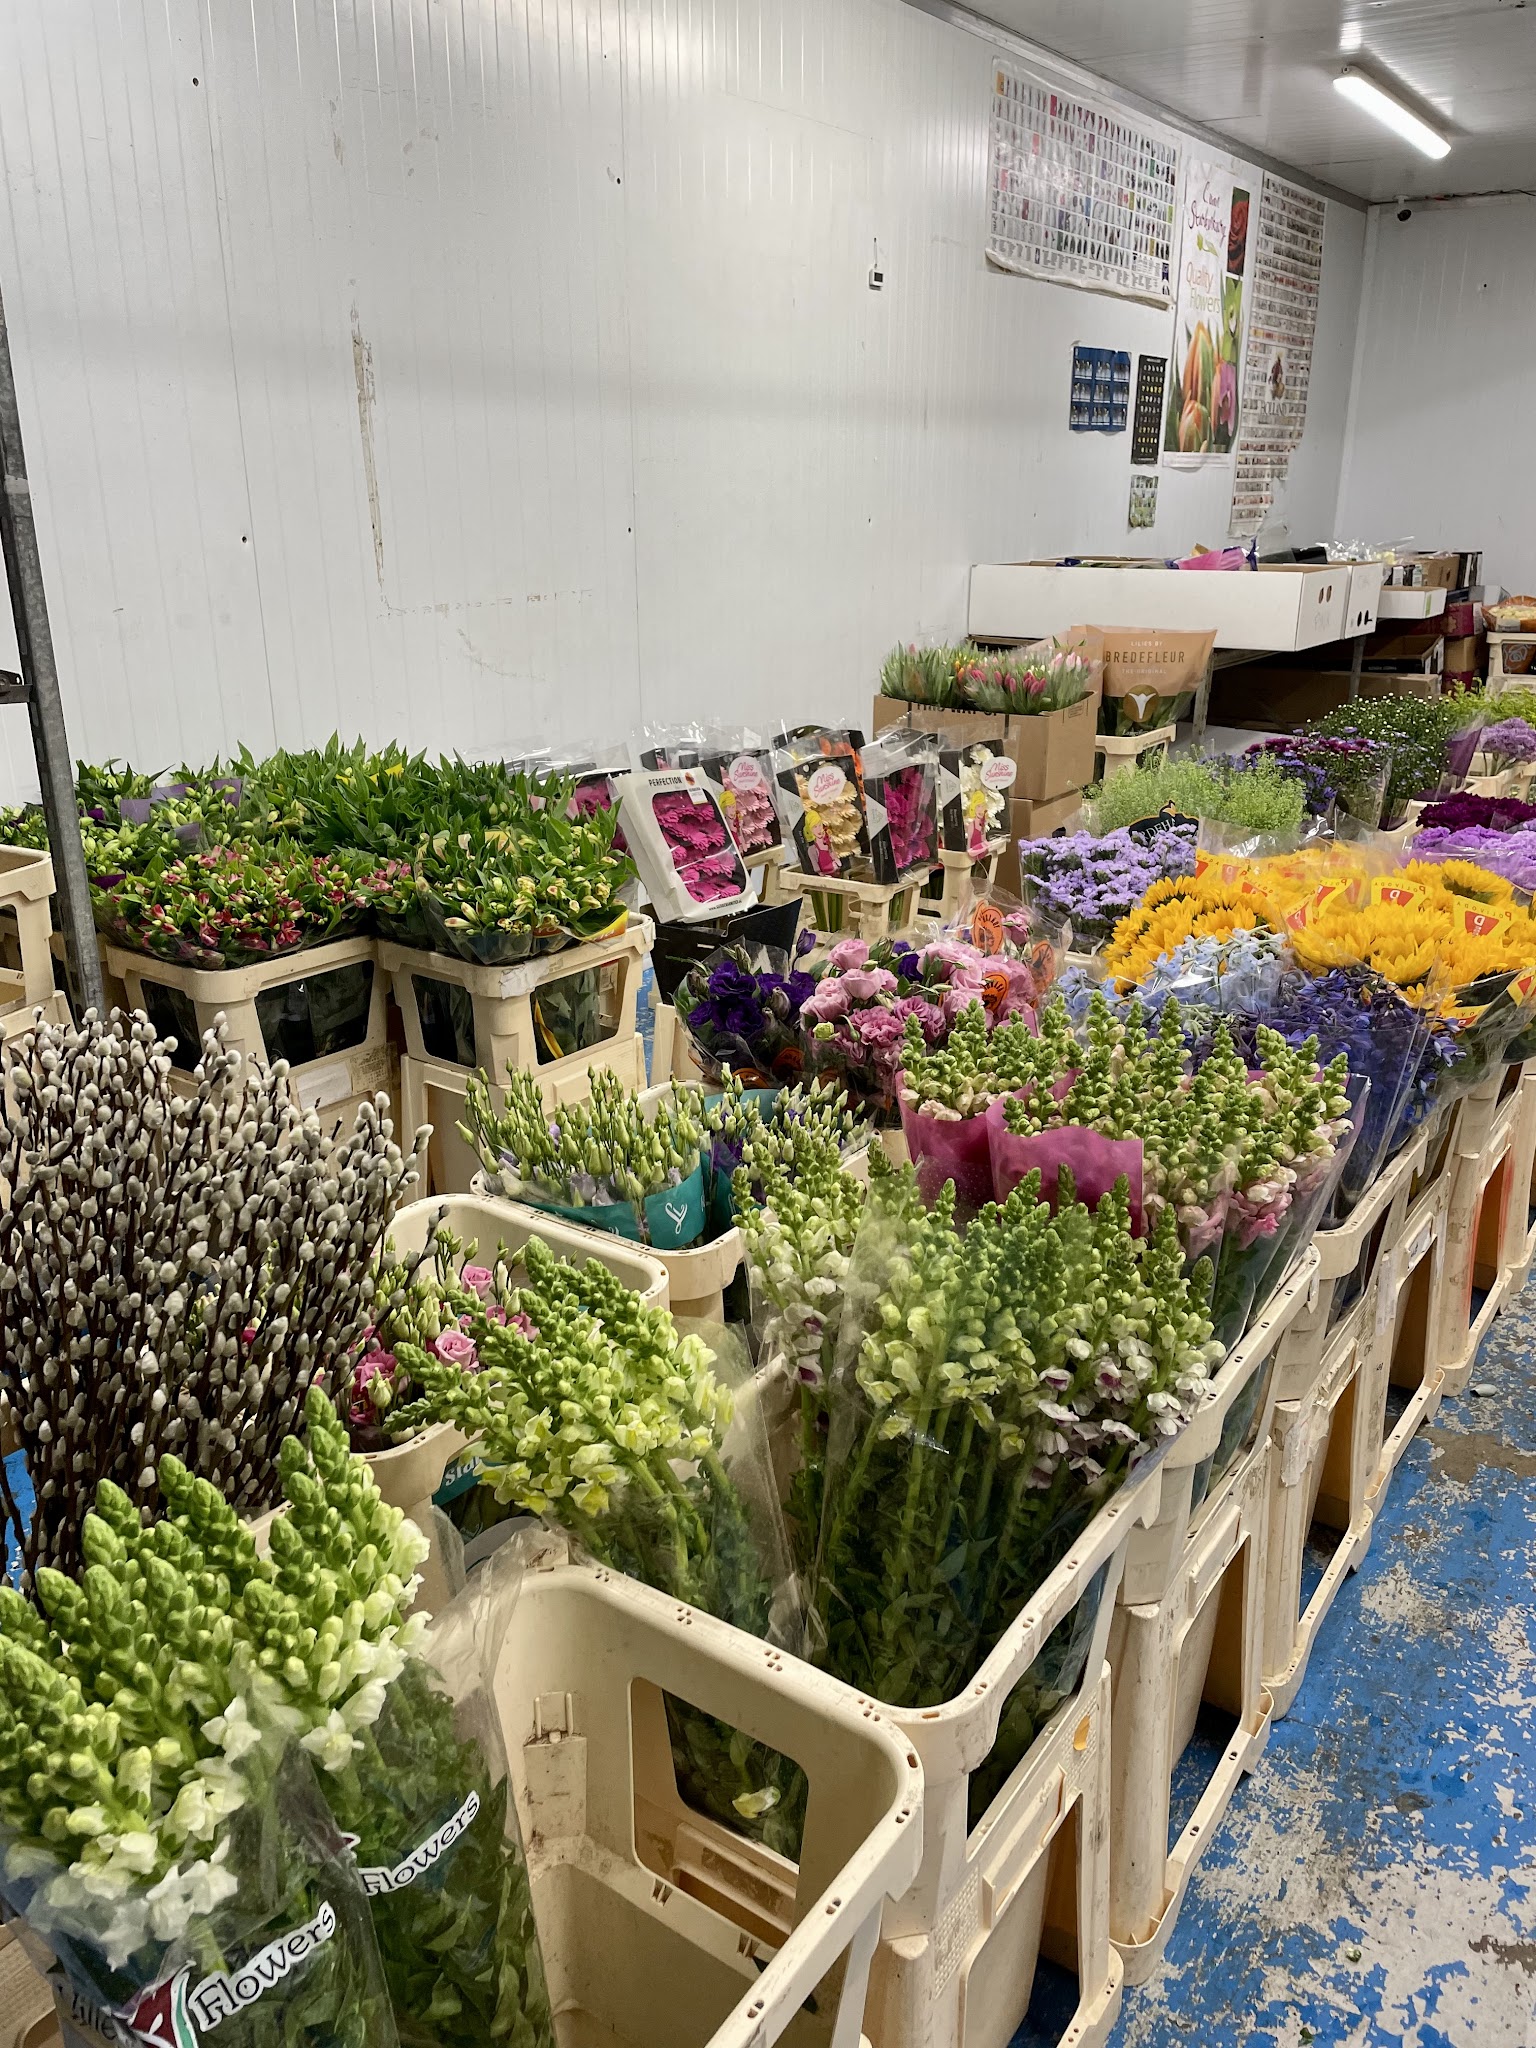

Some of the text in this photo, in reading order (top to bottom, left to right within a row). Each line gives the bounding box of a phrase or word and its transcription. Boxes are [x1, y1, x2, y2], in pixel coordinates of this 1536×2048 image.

[1186, 261, 1214, 294] Quality
[1190, 287, 1220, 314] Flowers
[1105, 650, 1185, 664] BREDEFLEUR
[738, 762, 755, 772] Miss
[990, 762, 1009, 772] Miss
[648, 776, 683, 787] PERFECTION
[816, 772, 835, 785] Miss
[361, 1796, 479, 1894] Flowers
[193, 1904, 335, 2026] Flowers
